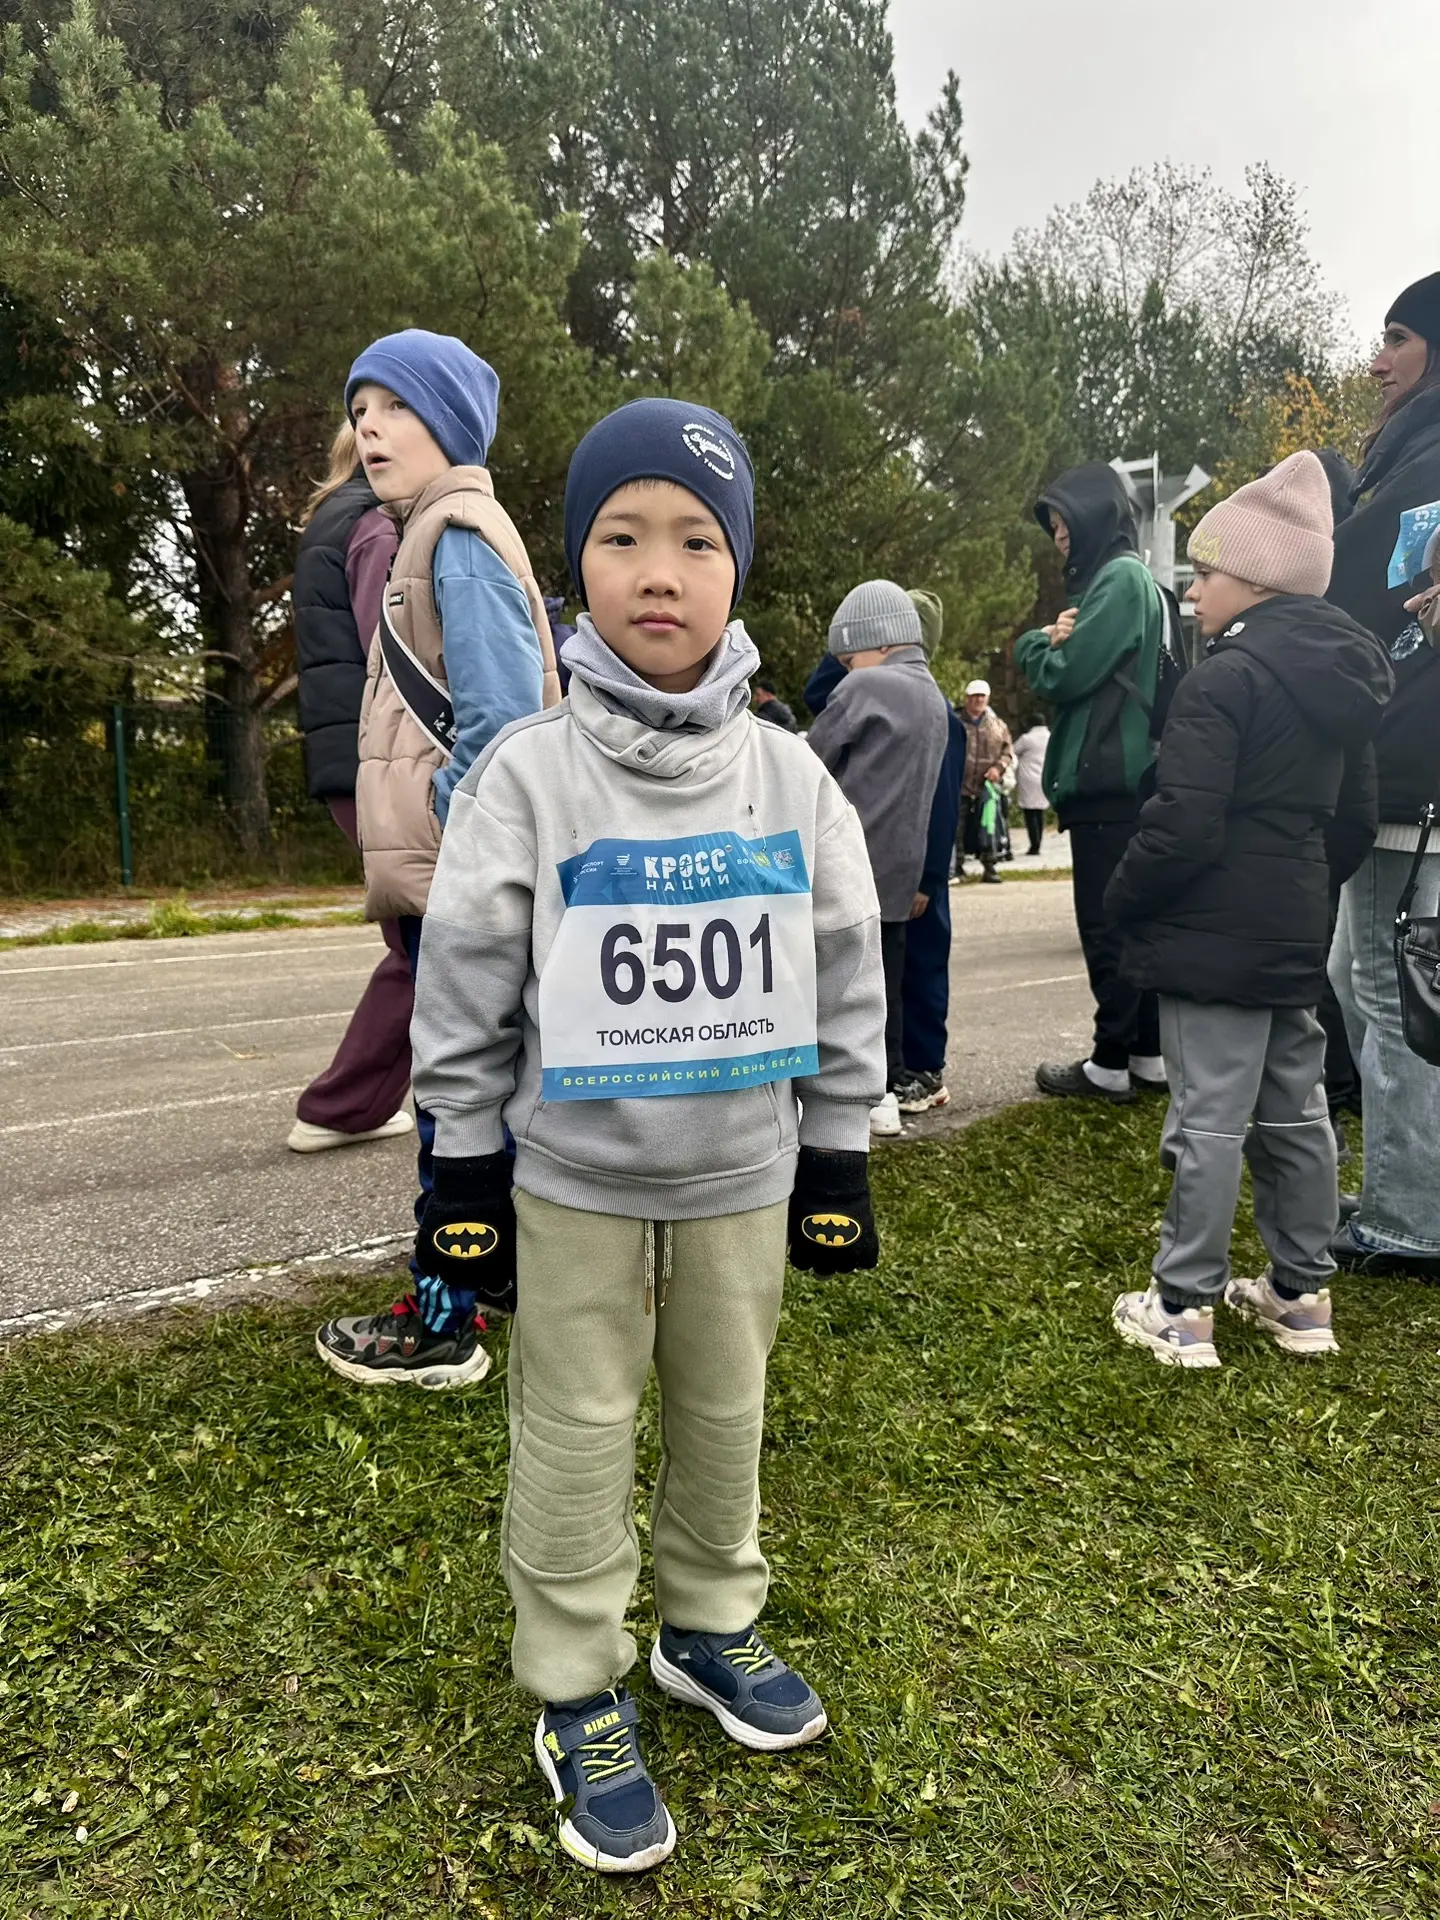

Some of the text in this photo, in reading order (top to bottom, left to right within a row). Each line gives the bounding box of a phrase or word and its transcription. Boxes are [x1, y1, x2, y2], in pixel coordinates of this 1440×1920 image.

[644, 848, 727, 879] КРОСС
[646, 873, 730, 892] НАЦИИ
[600, 913, 773, 1006] 6501
[596, 1017, 775, 1047] ТОМСКАЯ ОБЛАСТЬ
[563, 1056, 802, 1086] ВСЕРОССИЙСКИЙ ДЕНЬ БЕГА
[583, 1711, 621, 1736] BIKER
